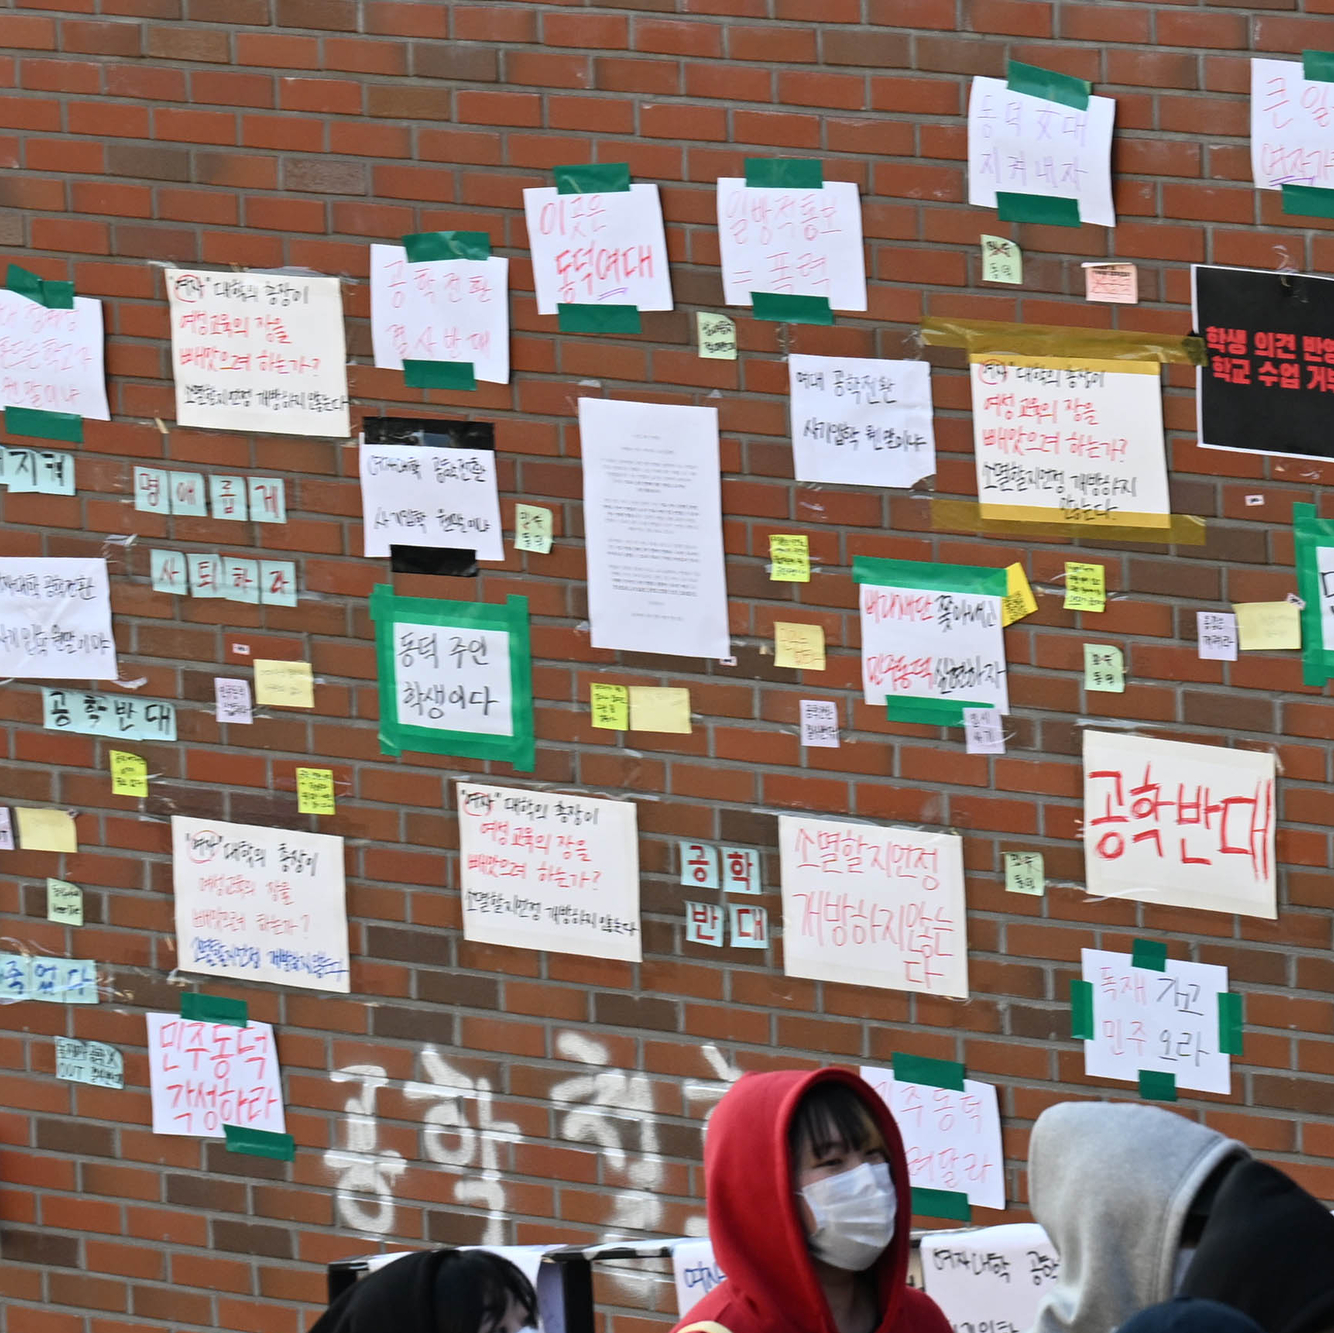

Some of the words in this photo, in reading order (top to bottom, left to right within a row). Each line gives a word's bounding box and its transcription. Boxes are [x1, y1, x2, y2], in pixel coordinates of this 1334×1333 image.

[555, 242, 655, 304] 동덕여대
[1205, 326, 1248, 353] 학생
[1254, 331, 1297, 359] 의견
[1211, 356, 1252, 385] 학교
[1258, 360, 1301, 390] 수업
[158, 553, 296, 596] 사퇴하라
[397, 632, 439, 671] 동덕
[449, 634, 491, 670] 주인
[49, 690, 172, 736] 공학반대
[402, 680, 499, 721] 학생이다
[1086, 761, 1272, 883] 공학반대
[556, 834, 592, 862] 장을
[687, 845, 755, 892] 공학
[793, 826, 941, 892] 소멸할지언정
[693, 904, 765, 946] 반대
[1098, 966, 1148, 1008] 독재
[159, 1021, 270, 1081] 민주동덕
[1101, 1018, 1148, 1058] 민주
[1158, 1029, 1210, 1068] 오라
[165, 1078, 279, 1134] 각성하라
